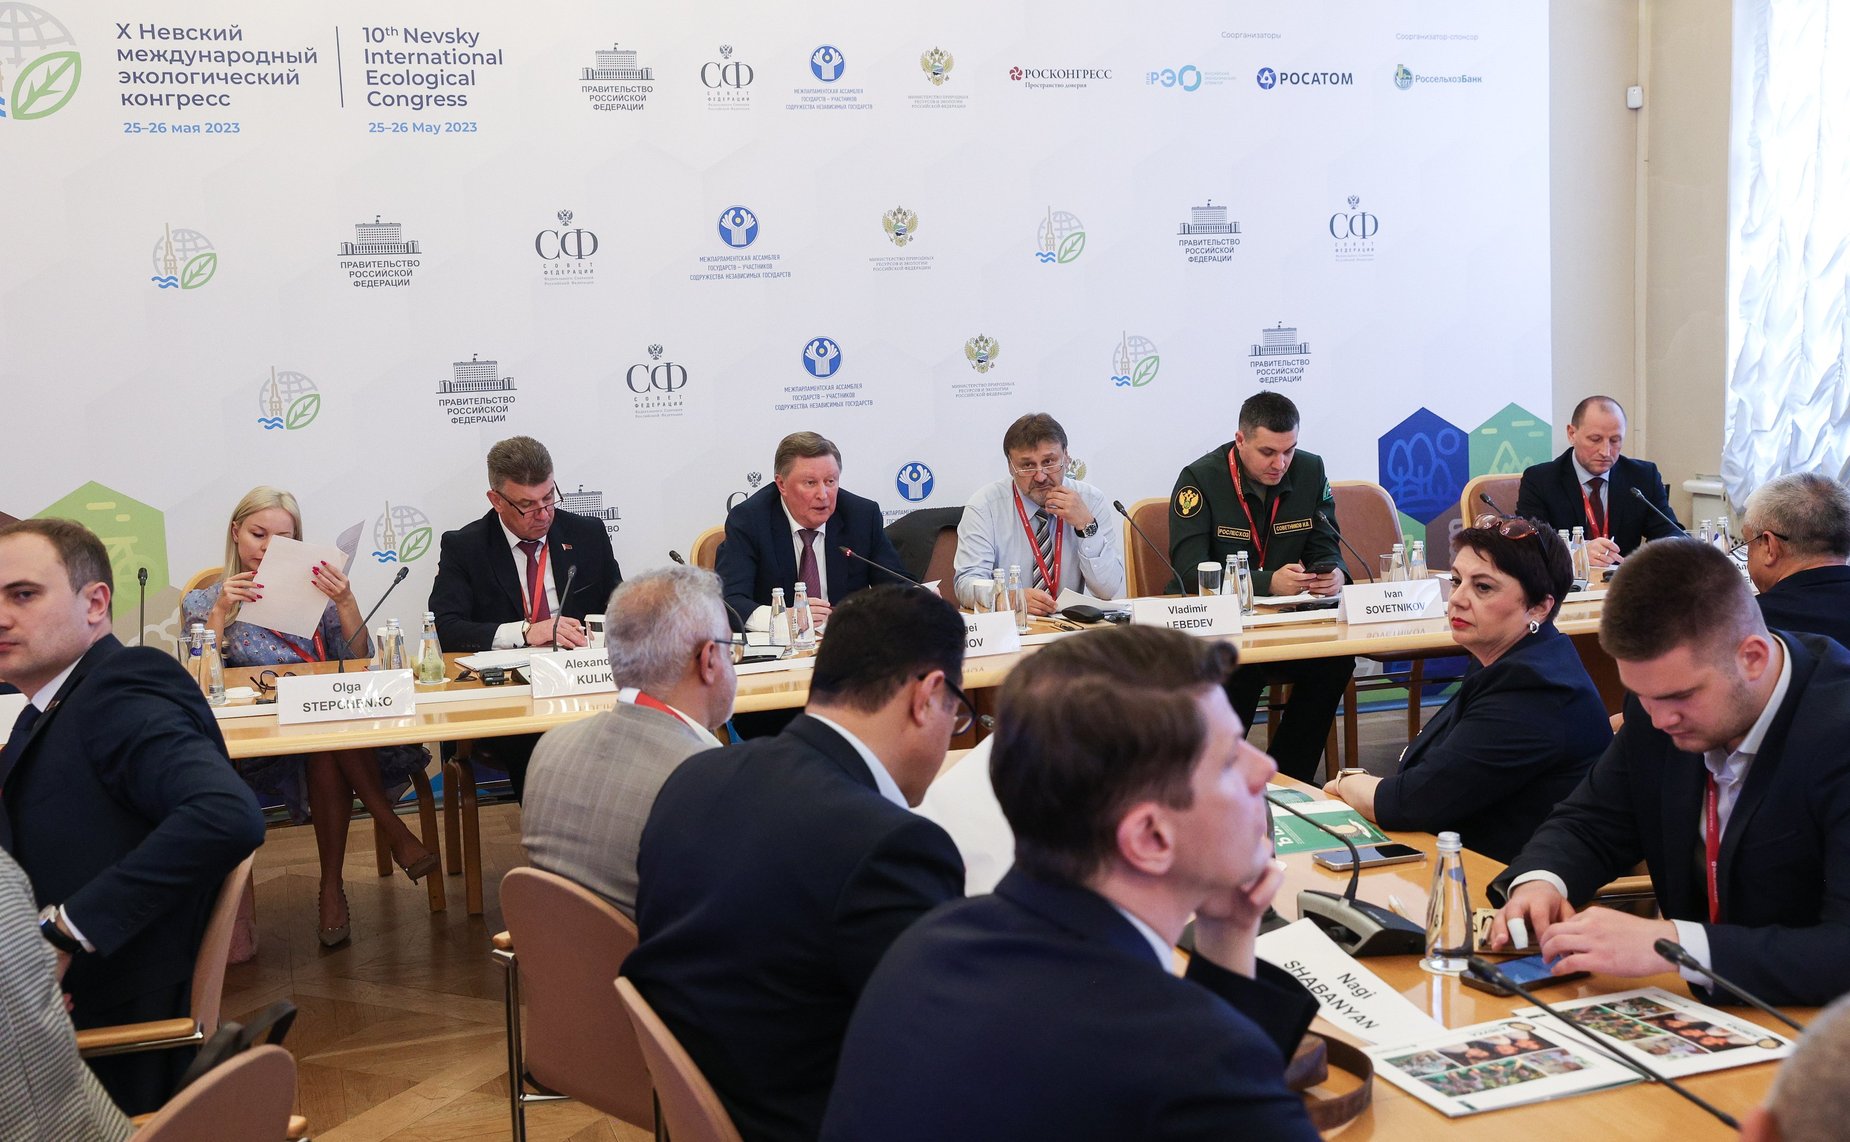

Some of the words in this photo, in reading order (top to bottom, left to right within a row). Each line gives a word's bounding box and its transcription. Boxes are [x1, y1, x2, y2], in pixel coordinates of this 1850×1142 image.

[139, 24, 243, 41] Невский
[403, 27, 480, 48] Nevsky
[1221, 31, 1282, 40] Соорганизаторы
[117, 47, 318, 67] международный
[364, 48, 503, 65] International
[118, 69, 300, 85] экологический
[366, 69, 475, 90] Ecological
[700, 61, 754, 89] СФ
[1024, 69, 1113, 79] РОСКОНГРЕСС
[1279, 72, 1353, 85] РОСАТОМ
[1415, 75, 1483, 83] РоссельхозБанк
[581, 85, 653, 94] ПРАВИТЕЛЬСТВО
[1024, 82, 1065, 90] Пространство
[121, 93, 231, 110] конгресс
[367, 91, 468, 111] Congress
[589, 94, 647, 102] РОССИЙСКОЙ
[593, 103, 644, 111] ФЕДЕРАЦИИ
[171, 124, 201, 133] мая
[204, 122, 241, 134] 2023
[412, 122, 441, 135] May
[445, 122, 478, 133] 2023
[1329, 211, 1379, 240] СФ
[535, 228, 599, 260] СФ
[1179, 238, 1241, 246] ПРАВИТЕЛЬСТВО
[1185, 246, 1235, 254] РОССИЙСКОЙ
[341, 260, 421, 269] ПРАВИТЕЛЬСТВО
[1188, 255, 1232, 263] ФЕДЕРАЦИИ
[350, 269, 413, 278] РОССИЙСКОЙ
[353, 279, 410, 288] ФЕДЕРАЦИИ
[1250, 358, 1311, 368] ПРАВИТЕЛЬСТВО
[1256, 367, 1305, 375] РОССИЙСКОЙ
[626, 361, 688, 394] СФ
[1259, 376, 1302, 384] ФЕДЕРАЦИИ
[438, 395, 516, 406] ПРАВИТЕЛЬСТВО
[447, 405, 509, 415] РОССИЙСКОЙ
[451, 414, 506, 424] ФЕДЕРАЦИИ
[1384, 590, 1403, 599] Ivan
[1168, 604, 1208, 615] Vladimir
[1366, 602, 1425, 615] SOVETNIKOV
[964, 623, 978, 635] gei
[1166, 618, 1214, 630] LEBEDEV
[565, 658, 611, 669] Alexand
[332, 682, 362, 694] Olga
[1337, 973, 1377, 1000] Nagi
[1284, 960, 1380, 1029] SHABANYAN
